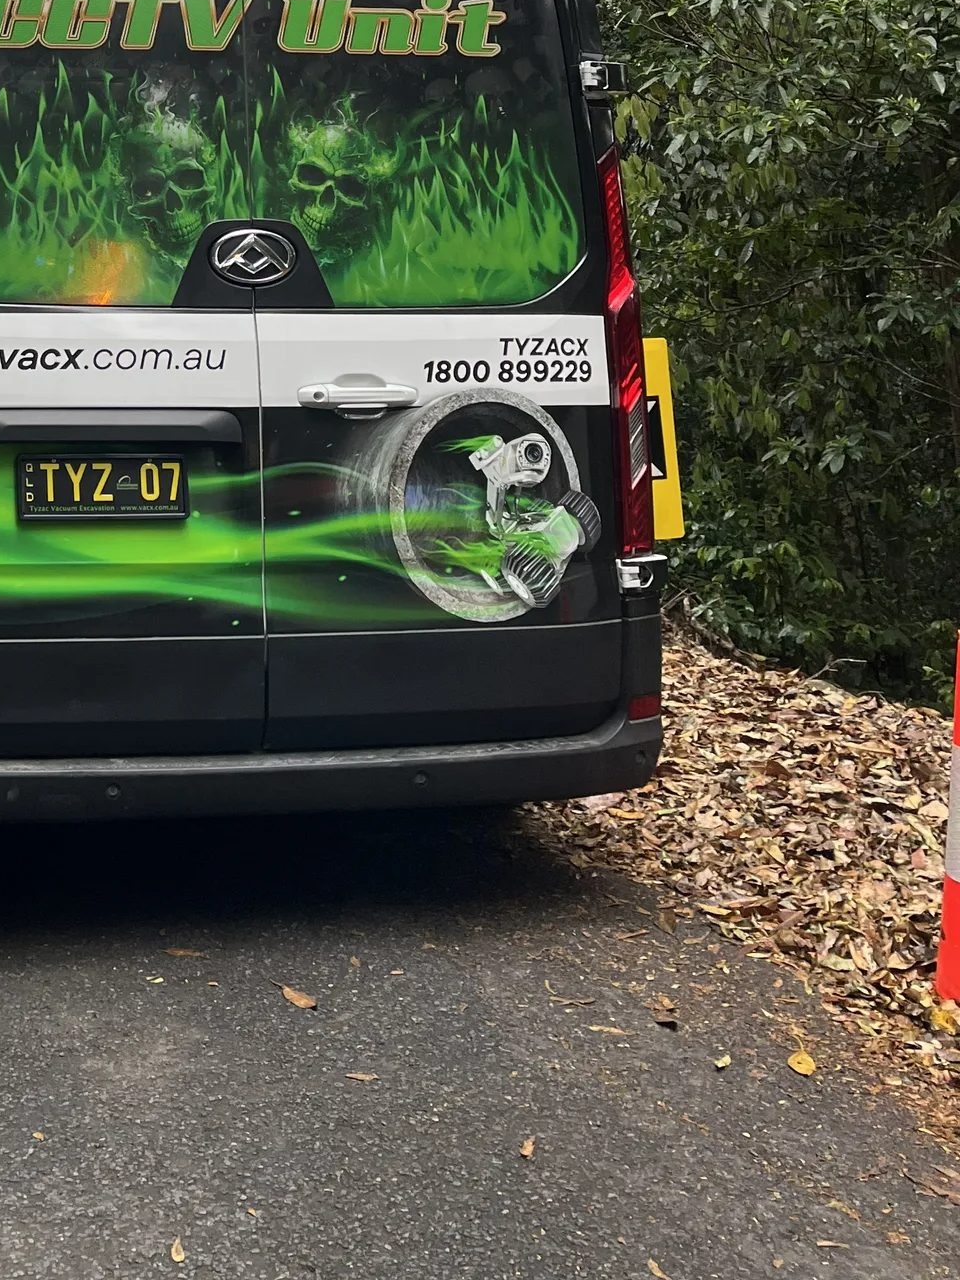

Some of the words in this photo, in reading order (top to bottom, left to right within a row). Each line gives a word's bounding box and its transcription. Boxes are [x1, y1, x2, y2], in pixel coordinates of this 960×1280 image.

[499, 338, 589, 356] TYZACX
[423, 360, 490, 383] 1800
[498, 360, 592, 383] 899229
[40, 463, 114, 502] TYZ
[140, 462, 180, 501] 07
[79, 504, 115, 512] Excavation
